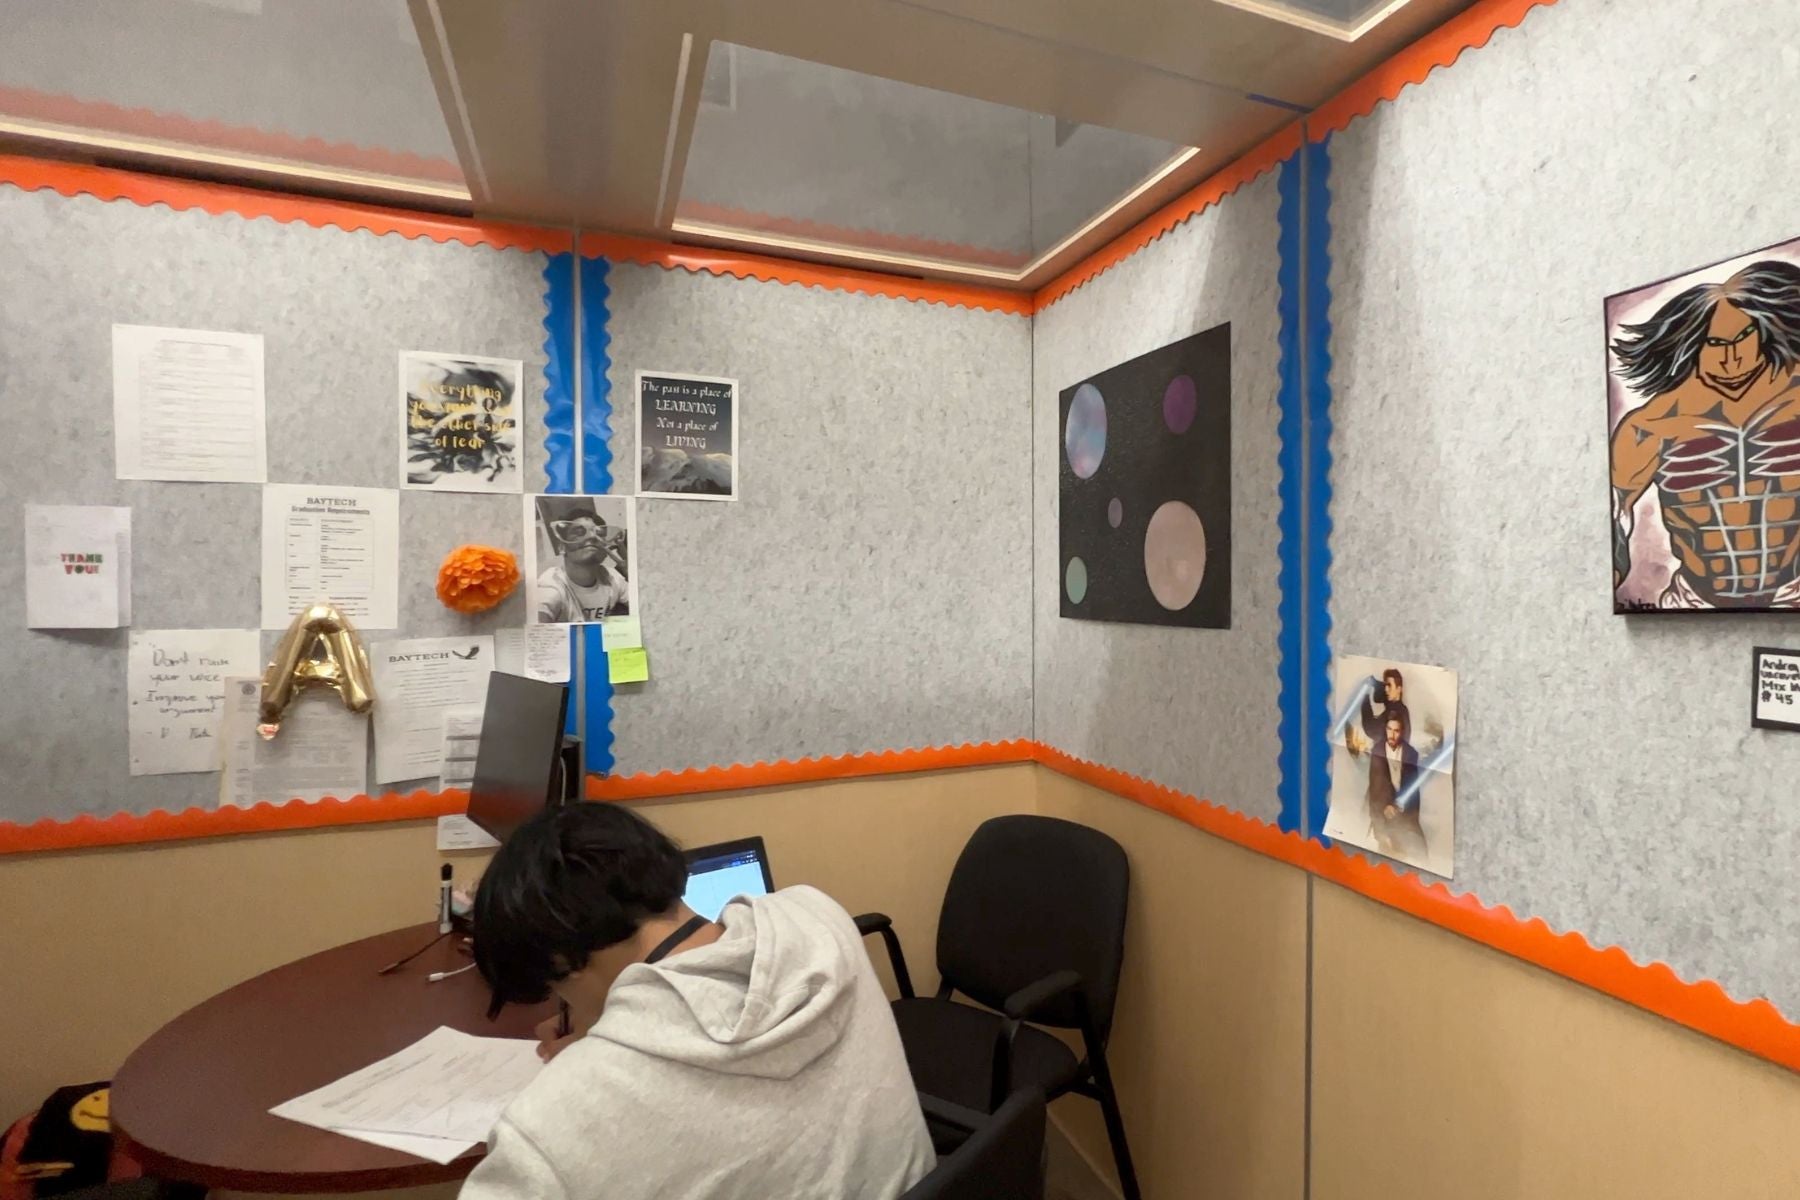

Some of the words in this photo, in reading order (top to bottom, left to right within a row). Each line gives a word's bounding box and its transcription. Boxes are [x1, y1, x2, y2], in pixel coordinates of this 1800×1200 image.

[642, 381, 659, 391] The
[662, 385, 679, 395] past
[682, 385, 690, 394] is
[700, 387, 721, 398] place
[656, 400, 716, 415] LEARNING
[657, 417, 674, 428] Not
[685, 420, 706, 432] place
[709, 422, 719, 431] of
[435, 436, 447, 447] of
[452, 436, 484, 449] fear
[666, 435, 706, 449] LIVING
[306, 497, 357, 507] BAYTECH
[388, 652, 450, 662] BAYTECH
[1775, 692, 1794, 705] 45
